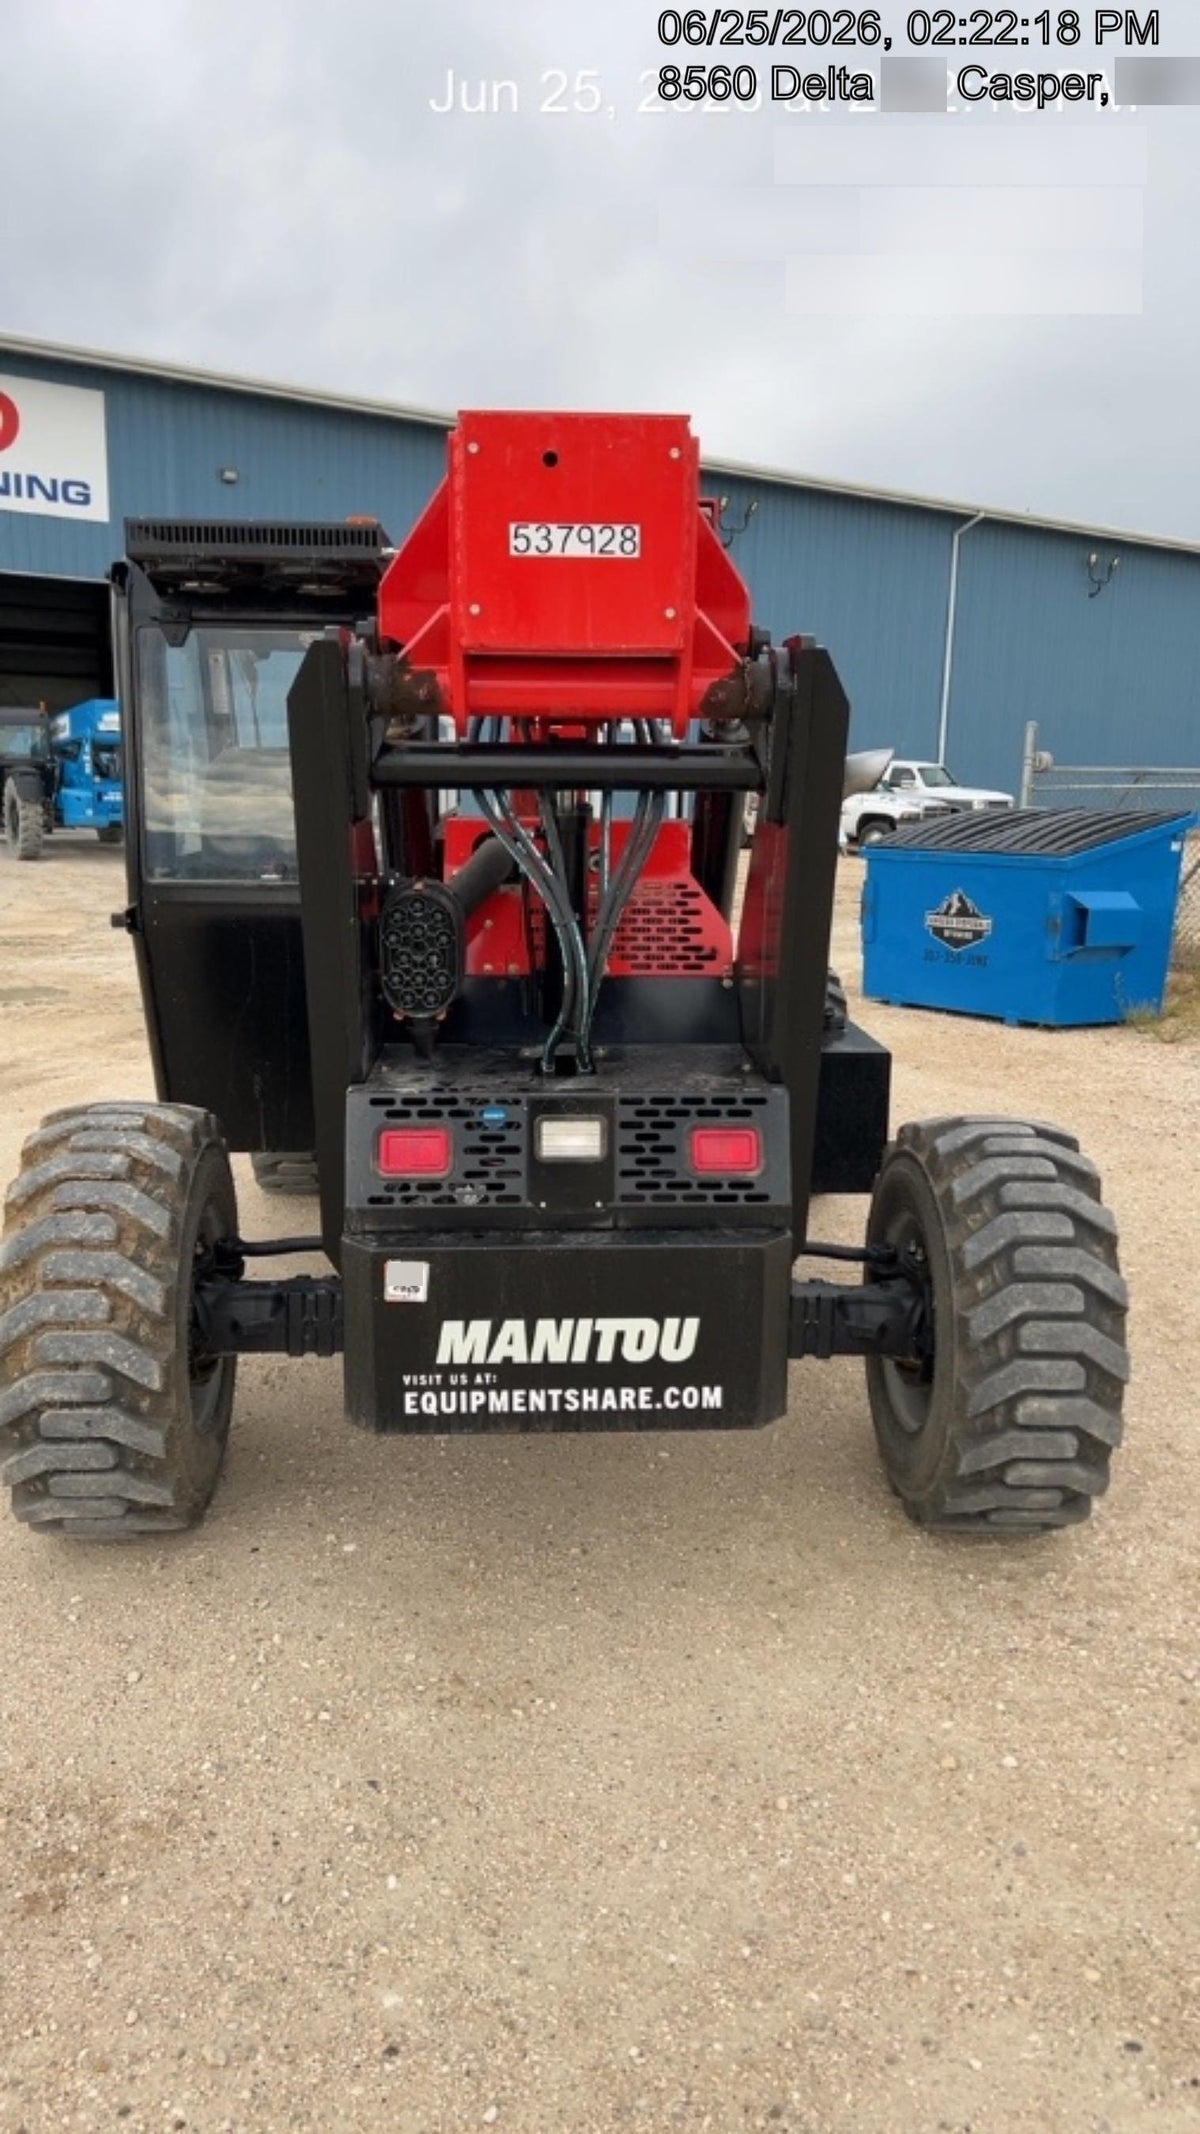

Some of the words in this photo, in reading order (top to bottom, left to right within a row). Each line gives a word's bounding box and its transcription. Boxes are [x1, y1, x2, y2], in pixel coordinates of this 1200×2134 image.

[513, 523, 638, 555] 537928
[436, 1317, 700, 1364] MANITOU
[402, 1374, 442, 1386] VISIT
[450, 1373, 468, 1385] US
[474, 1372, 498, 1384] AT:
[404, 1386, 723, 1416] EQUIPMENTSHARE.COM
